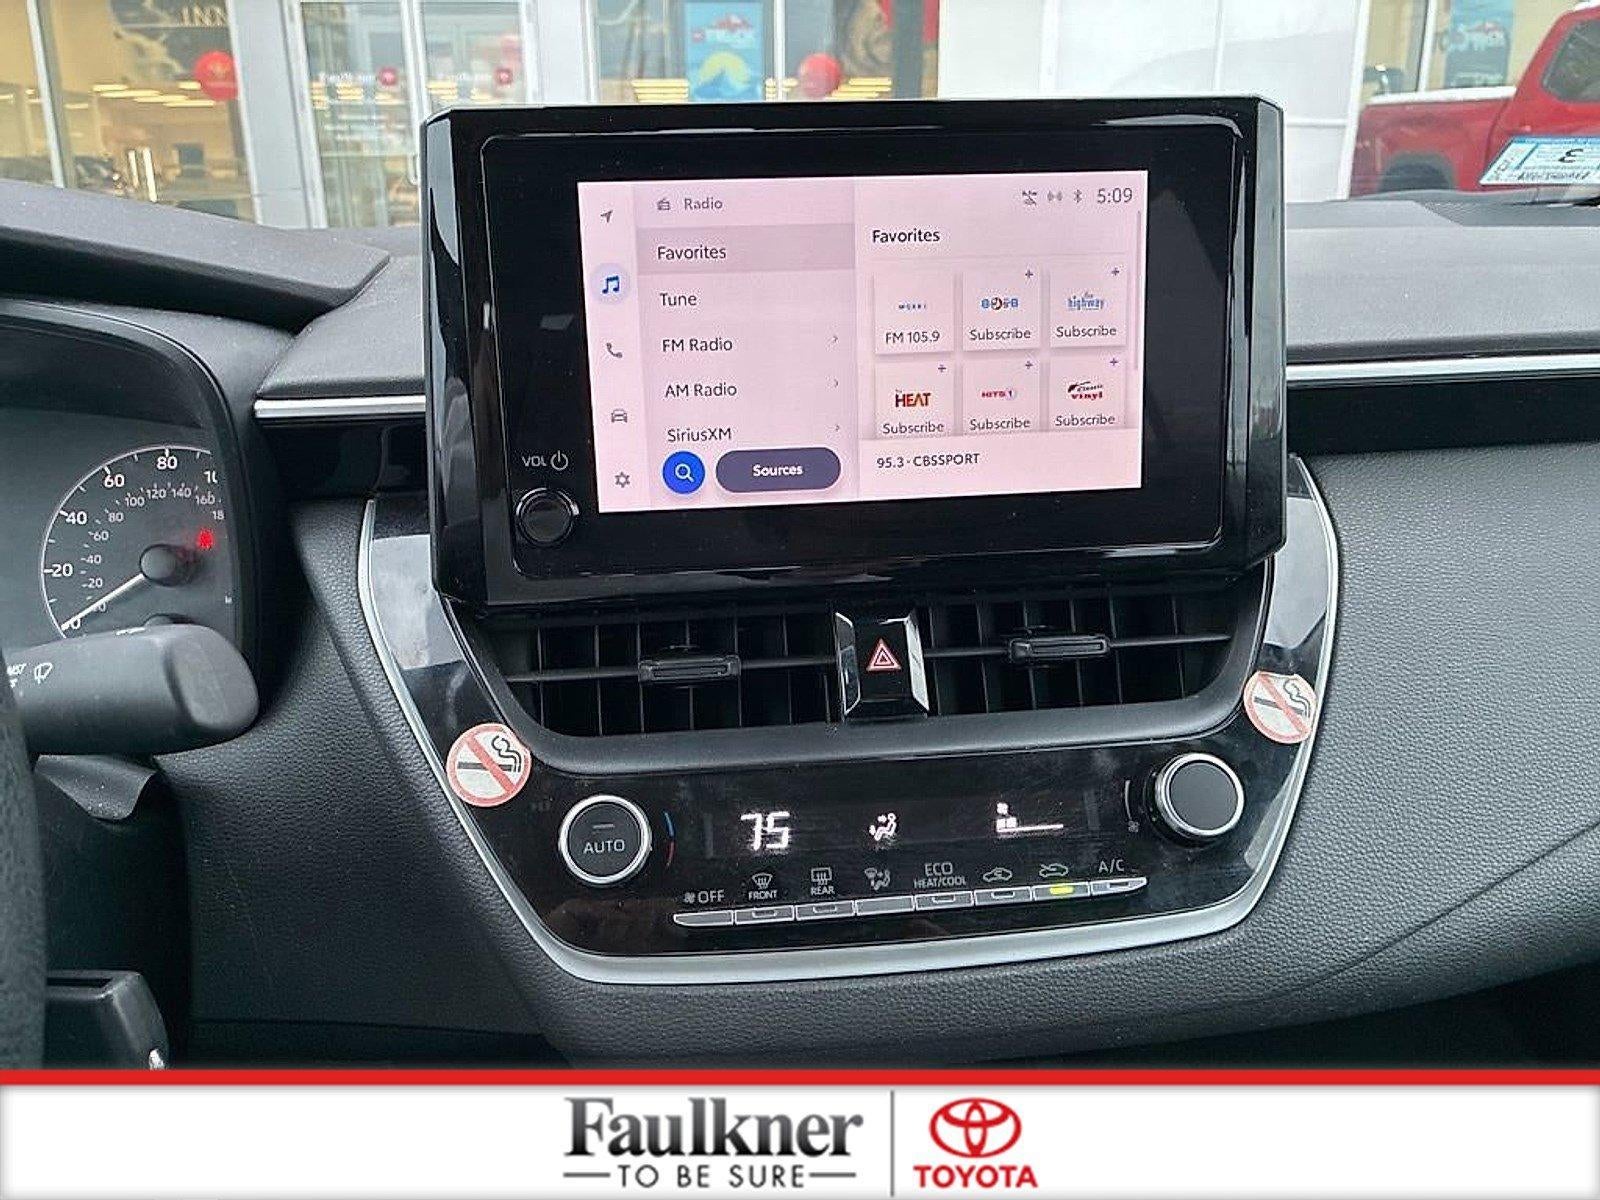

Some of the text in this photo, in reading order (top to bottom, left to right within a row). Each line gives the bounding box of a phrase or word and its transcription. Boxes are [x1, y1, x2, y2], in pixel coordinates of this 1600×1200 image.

[1097, 188, 1133, 203] 5:09
[684, 198, 723, 211] Radio
[872, 229, 940, 244] Favorites
[657, 245, 727, 260] Favorites
[660, 293, 698, 306] Tune
[885, 331, 940, 344] FM 105.9
[969, 328, 1031, 341] Subscribe
[1056, 325, 1117, 338] Subscribe
[662, 337, 733, 352] FM Radio
[665, 383, 737, 398] AM Radio
[895, 392, 931, 408] HEAT
[970, 417, 1031, 430] Subscribe
[1055, 415, 1115, 427] Subscribe
[667, 427, 733, 442] SiriusXM
[883, 422, 944, 434] Subscribe
[156, 456, 178, 470] 80
[522, 455, 547, 467] VOL
[752, 463, 803, 477] Sources
[104, 474, 125, 488] 60
[147, 487, 167, 499] 120
[172, 487, 191, 498] 140
[195, 492, 216, 506] 160
[125, 495, 145, 507] 100
[66, 511, 88, 525] 40
[108, 511, 124, 522] 80
[93, 530, 109, 541] 60
[86, 554, 102, 565] 40
[52, 563, 73, 577] 20
[88, 578, 103, 588] 20
[740, 811, 790, 851] 75
[583, 839, 625, 854] AUTO
[925, 862, 953, 877] ECO
[1099, 859, 1125, 873] A/C
[913, 876, 967, 889] HEAT/COOL
[697, 889, 725, 904] OFF
[748, 889, 778, 900] FRONT
[811, 885, 835, 896] REAR
